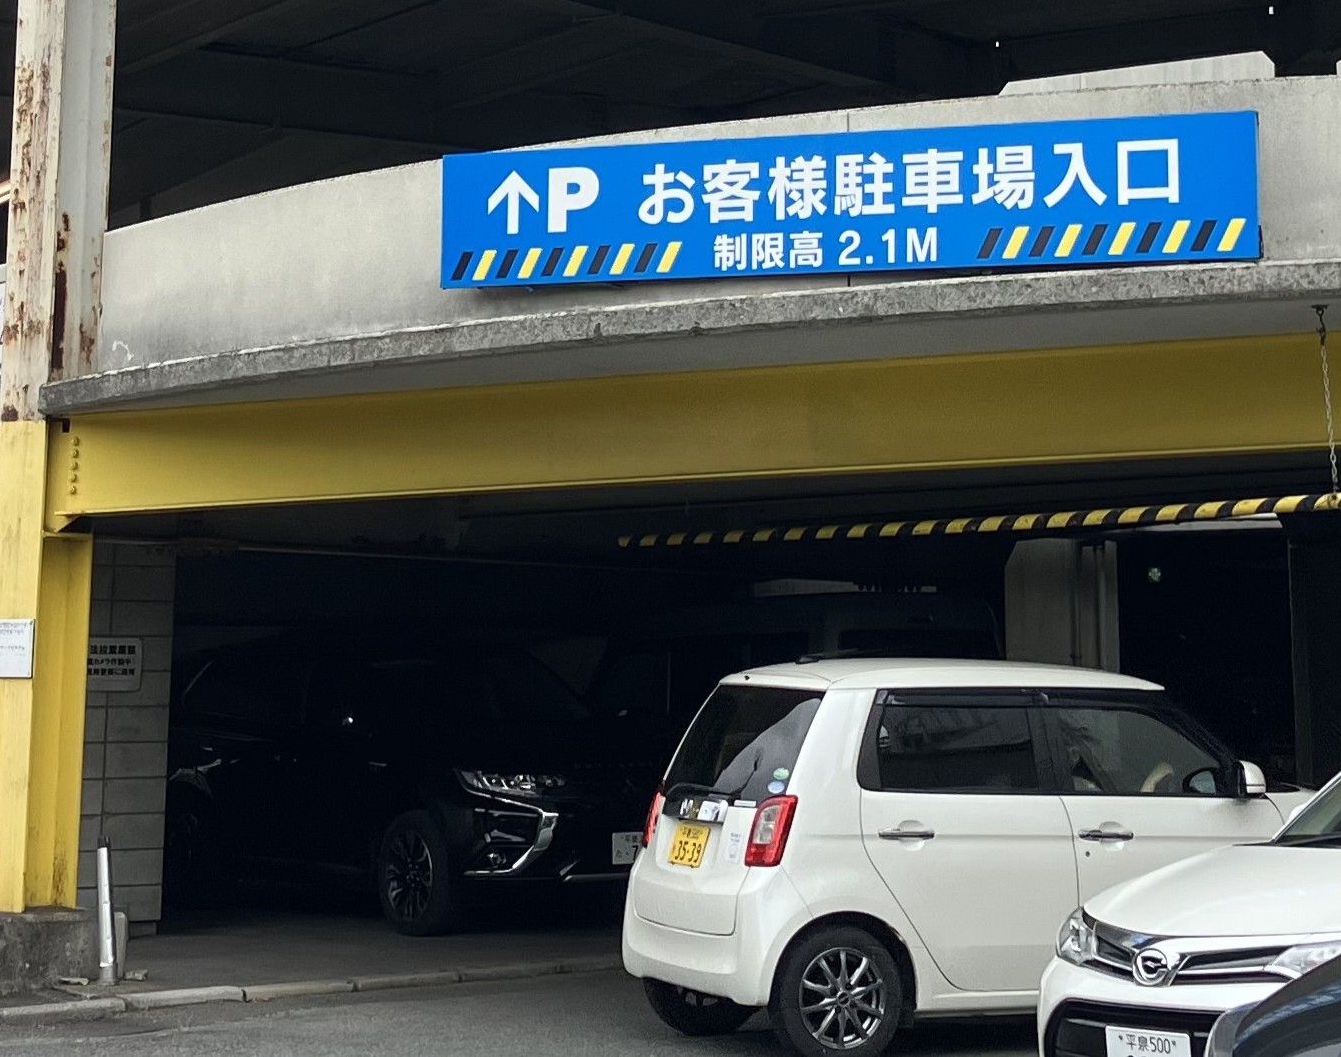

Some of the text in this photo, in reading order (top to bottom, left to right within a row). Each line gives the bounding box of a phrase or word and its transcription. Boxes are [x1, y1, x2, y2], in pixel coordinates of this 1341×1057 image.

[546, 138, 1183, 234] P お客様駐車場入口
[711, 228, 939, 272] 制限高 2.1M
[1125, 1034, 1172, 1055] 平泉500
